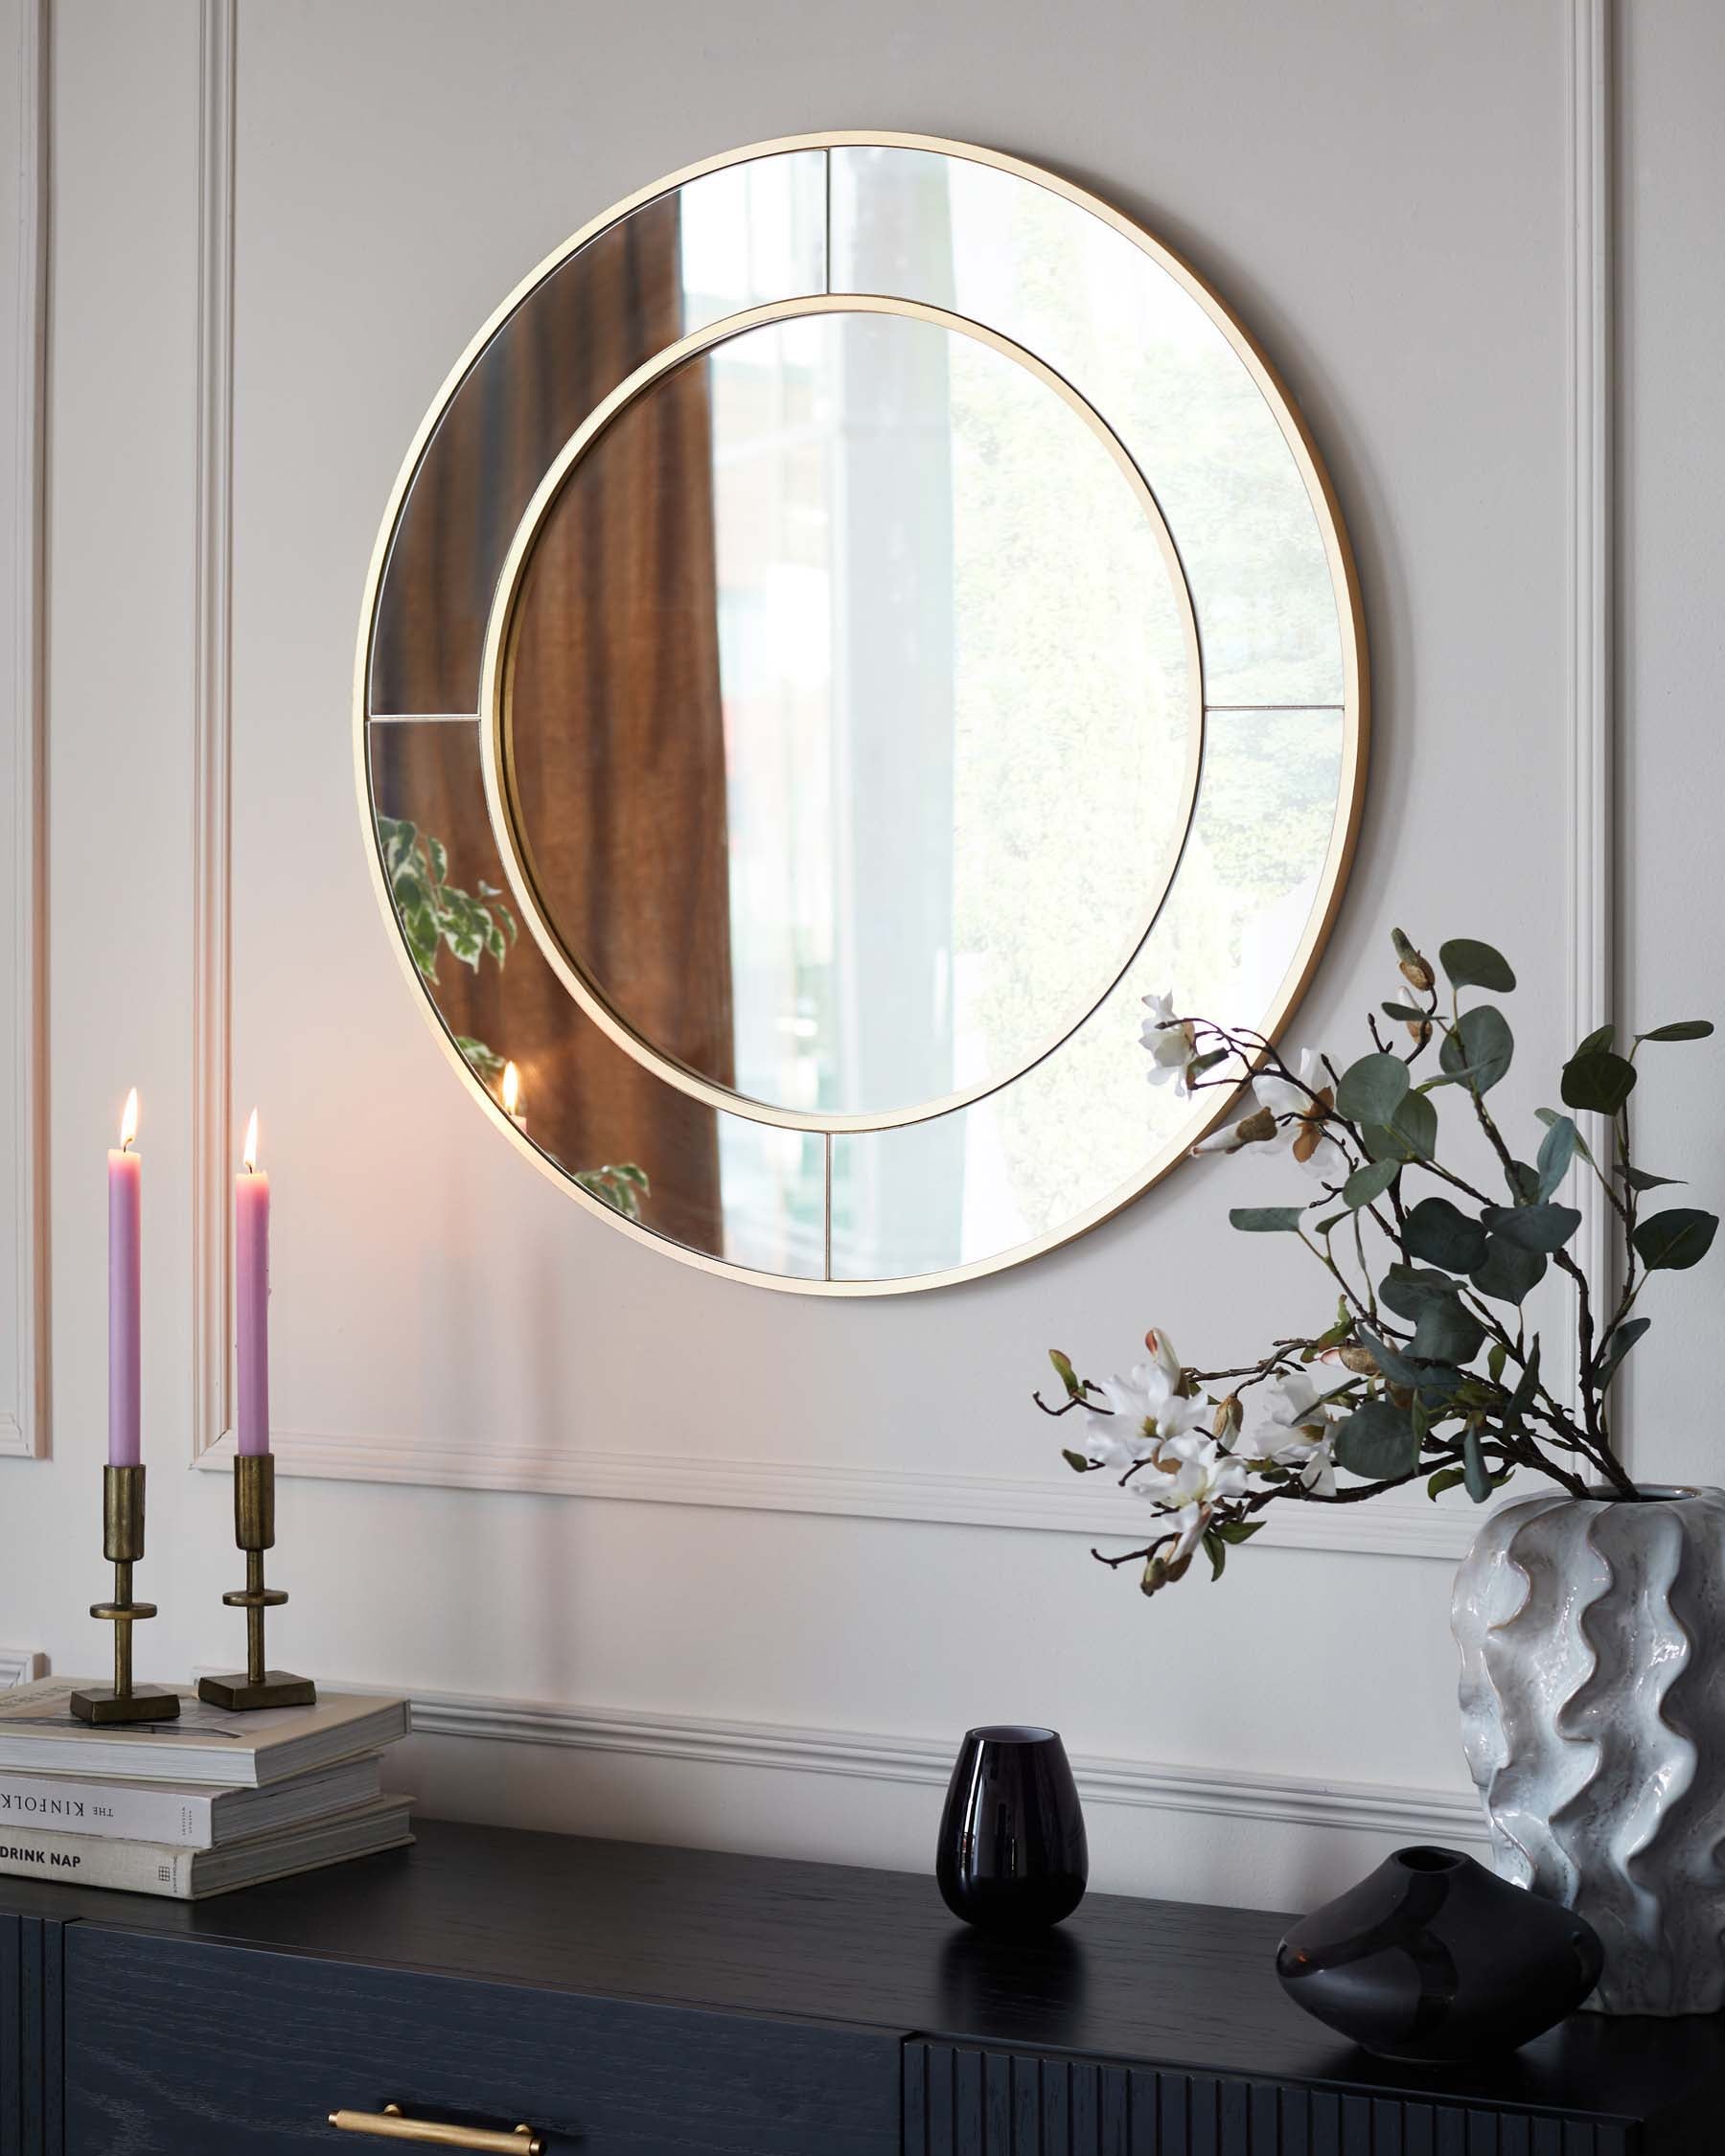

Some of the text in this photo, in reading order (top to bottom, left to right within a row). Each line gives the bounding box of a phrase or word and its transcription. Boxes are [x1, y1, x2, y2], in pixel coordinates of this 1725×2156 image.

[0, 1793, 114, 1817] THE KINFOLK
[0, 1846, 80, 1868] DRINK NAP
